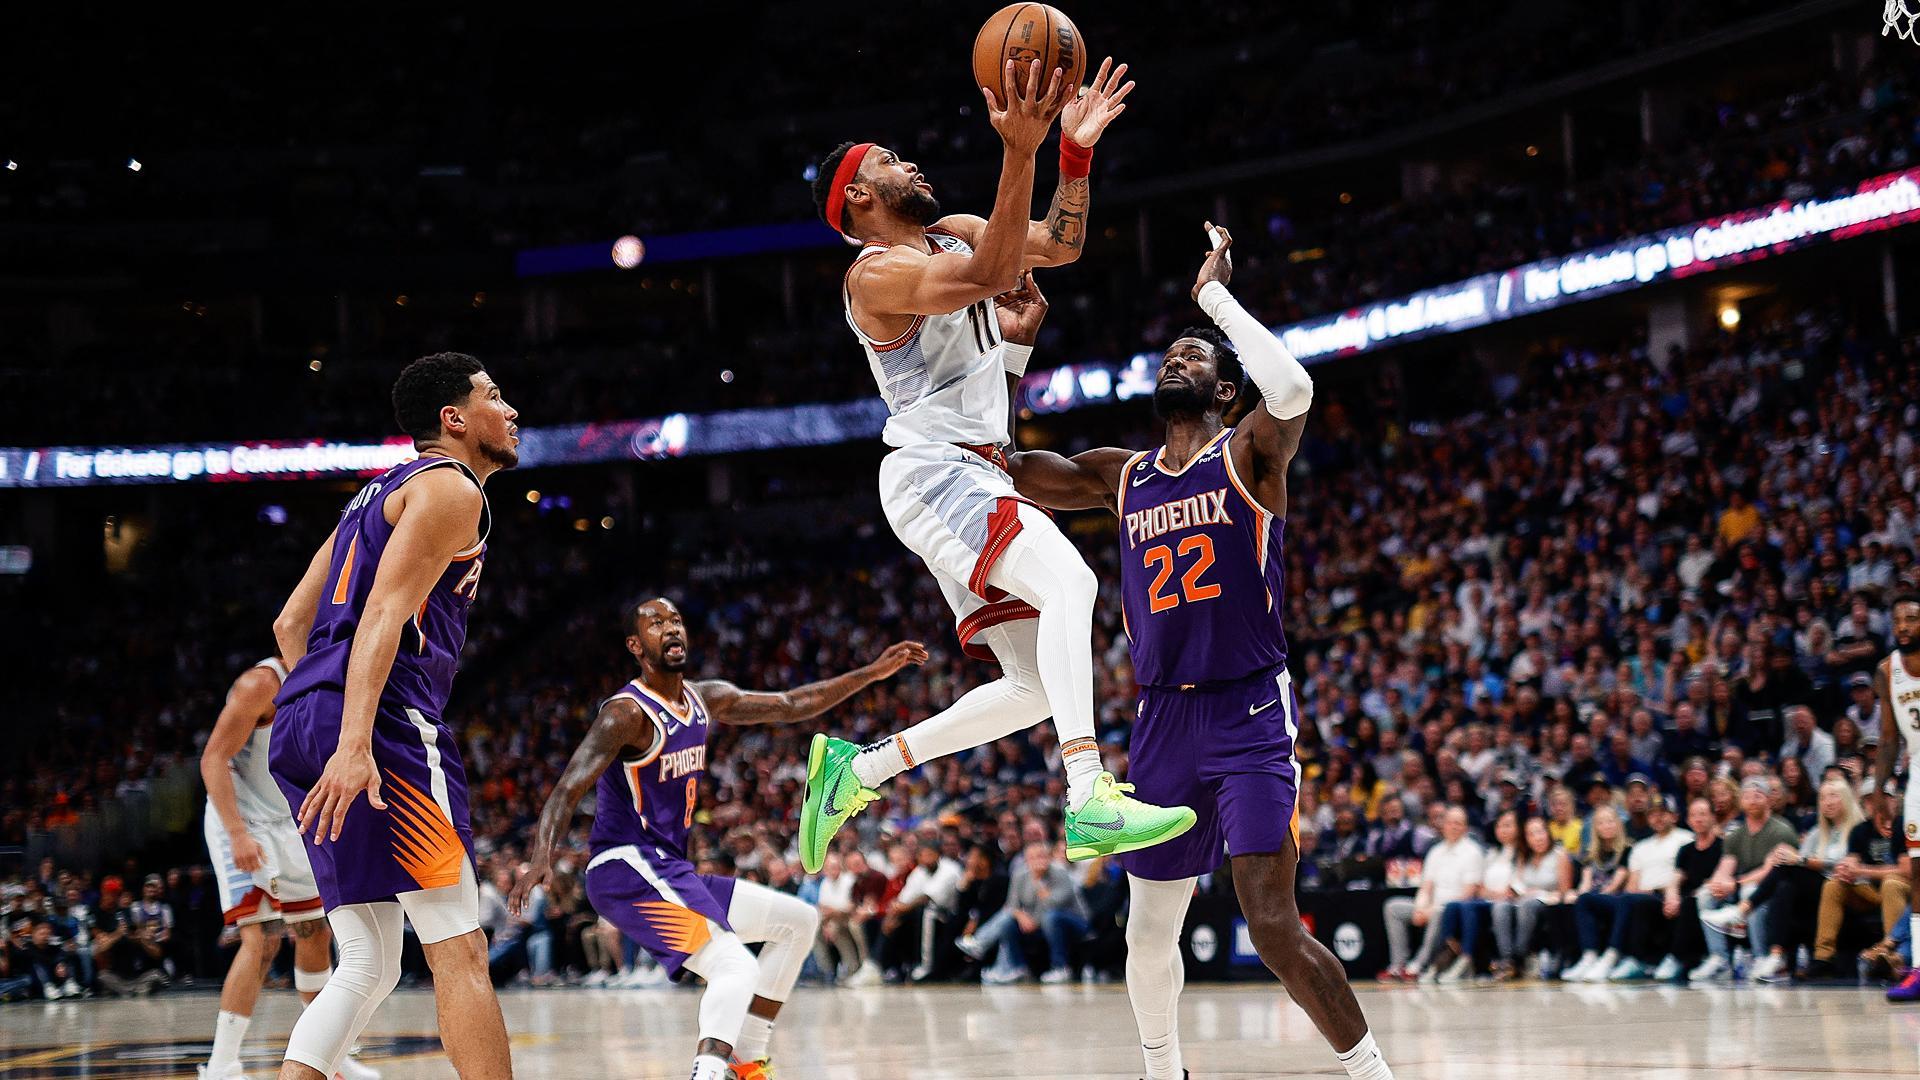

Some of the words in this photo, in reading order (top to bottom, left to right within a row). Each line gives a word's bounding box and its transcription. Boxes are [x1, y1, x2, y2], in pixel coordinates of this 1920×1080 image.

[1635, 243, 1667, 283] go
[1665, 236, 1694, 269] to
[966, 298, 999, 357] 11
[56, 451, 94, 479] For
[94, 449, 172, 478] tickets
[172, 451, 204, 481] go
[204, 447, 231, 475] to
[1136, 461, 1148, 471] 6
[1198, 450, 1222, 465] PayPal
[1125, 487, 1233, 550] PHOENIX
[1143, 533, 1222, 614] 22
